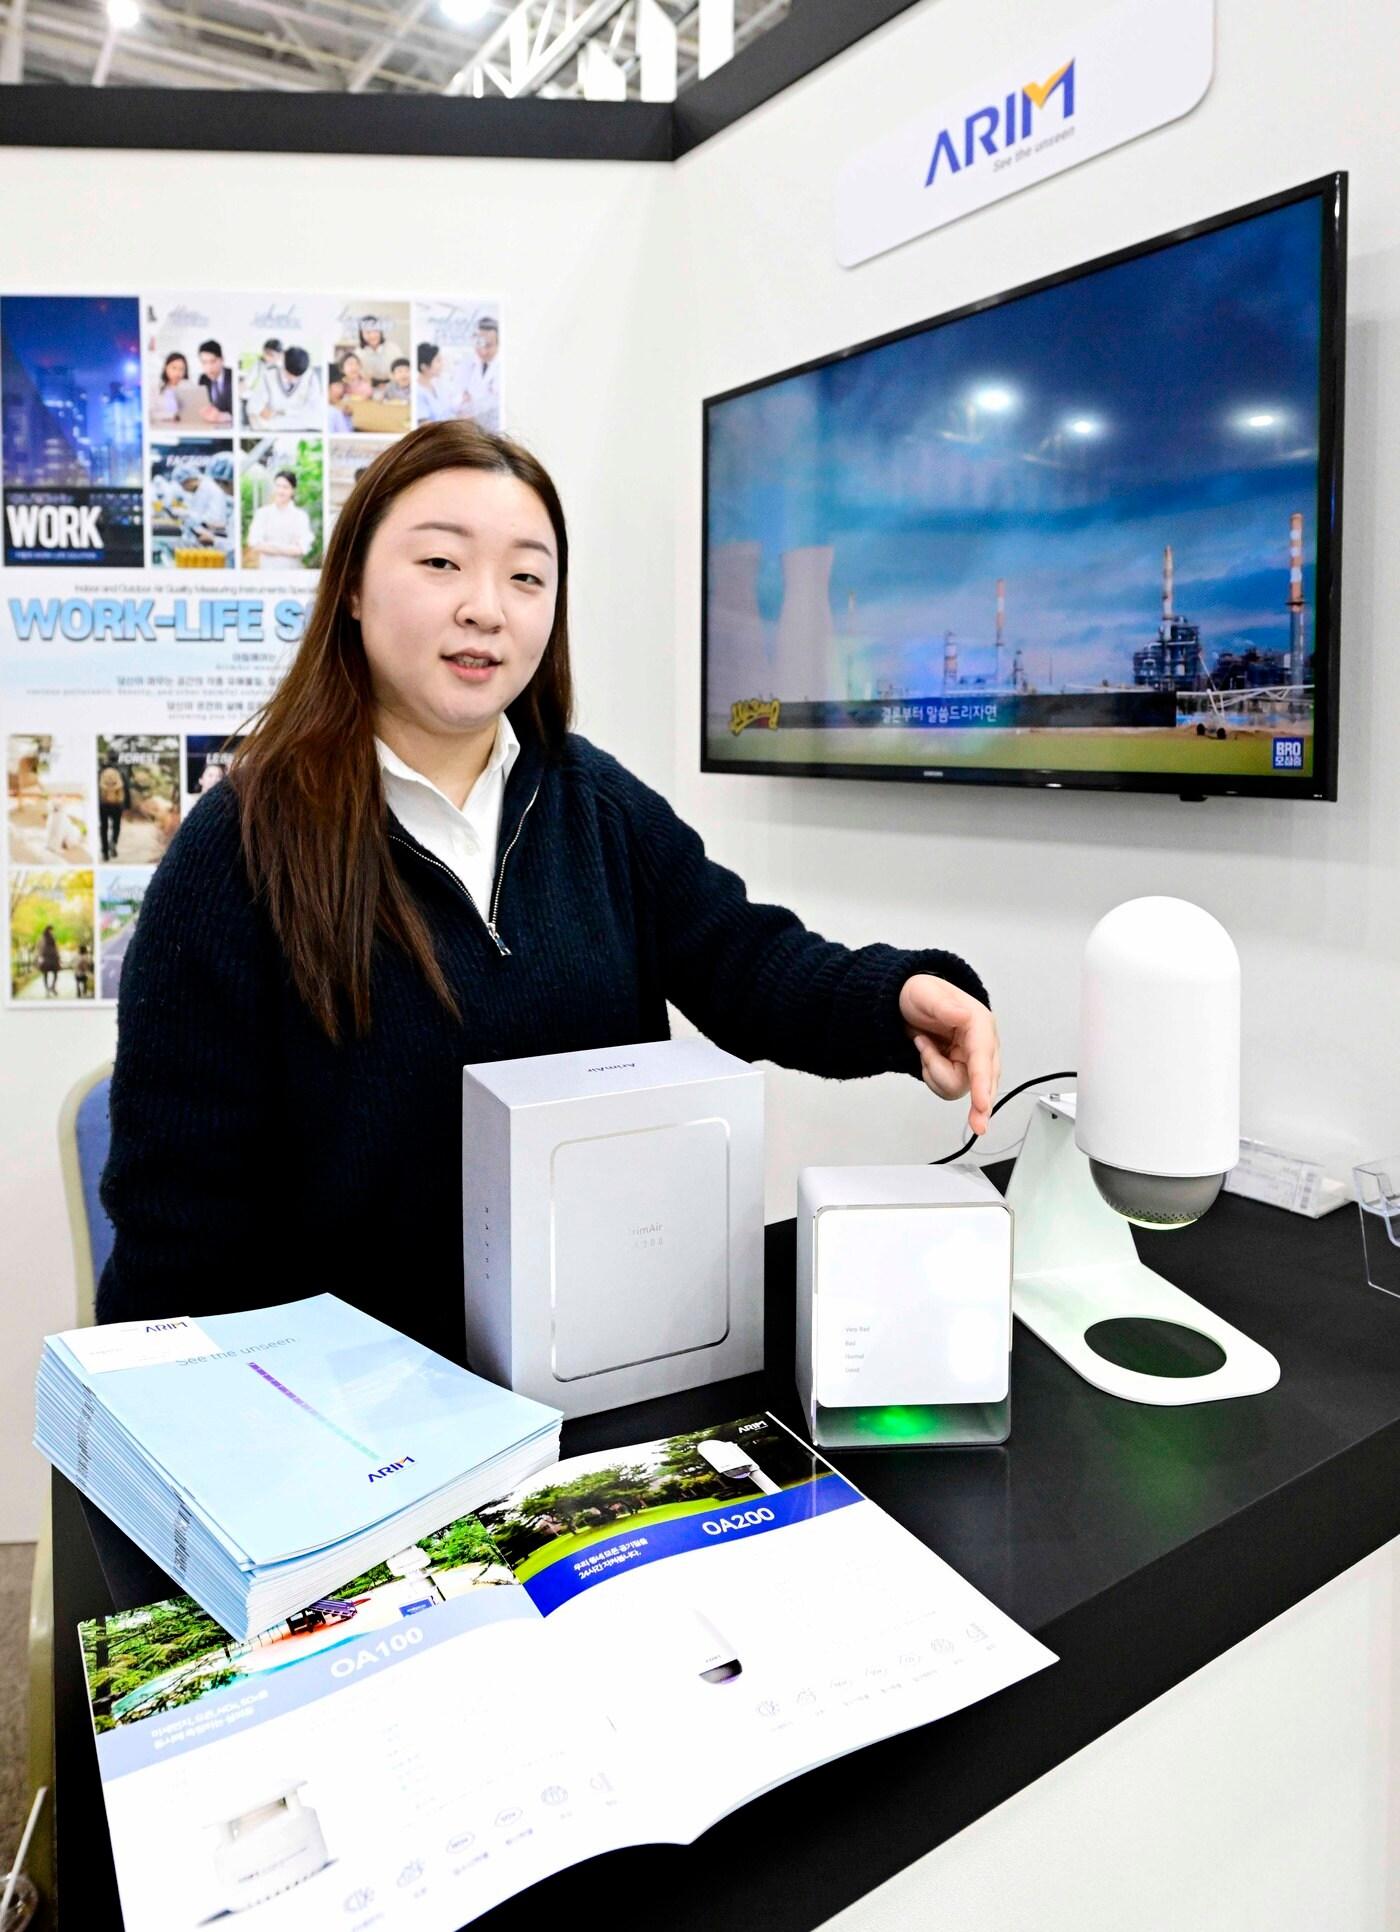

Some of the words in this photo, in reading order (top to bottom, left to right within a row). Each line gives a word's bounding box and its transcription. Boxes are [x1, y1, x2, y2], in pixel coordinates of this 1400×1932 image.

[924, 57, 1076, 188] ARIM
[993, 157, 1012, 173] See
[1015, 145, 1032, 163] the
[1034, 126, 1075, 152] unseen
[7, 504, 105, 550] WORK
[75, 584, 100, 593] Indoor
[103, 584, 118, 593] and
[119, 584, 151, 593] Outdoor
[166, 584, 193, 595] Quality
[195, 585, 238, 596] Measuring
[239, 586, 287, 595] Instruments
[8, 598, 265, 642] WORK-LIFE
[275, 598, 313, 642] S
[882, 705, 923, 724] 결론부터
[926, 704, 997, 724] 말씀드리자면
[1275, 741, 1302, 756] BRO
[145, 1321, 188, 1333] ARIM
[240, 1336, 297, 1355] unseen
[738, 1420, 767, 1434] ARIM
[367, 1456, 415, 1483] ARIM
[701, 1507, 775, 1536] OA200
[330, 1626, 424, 1679] OA100
